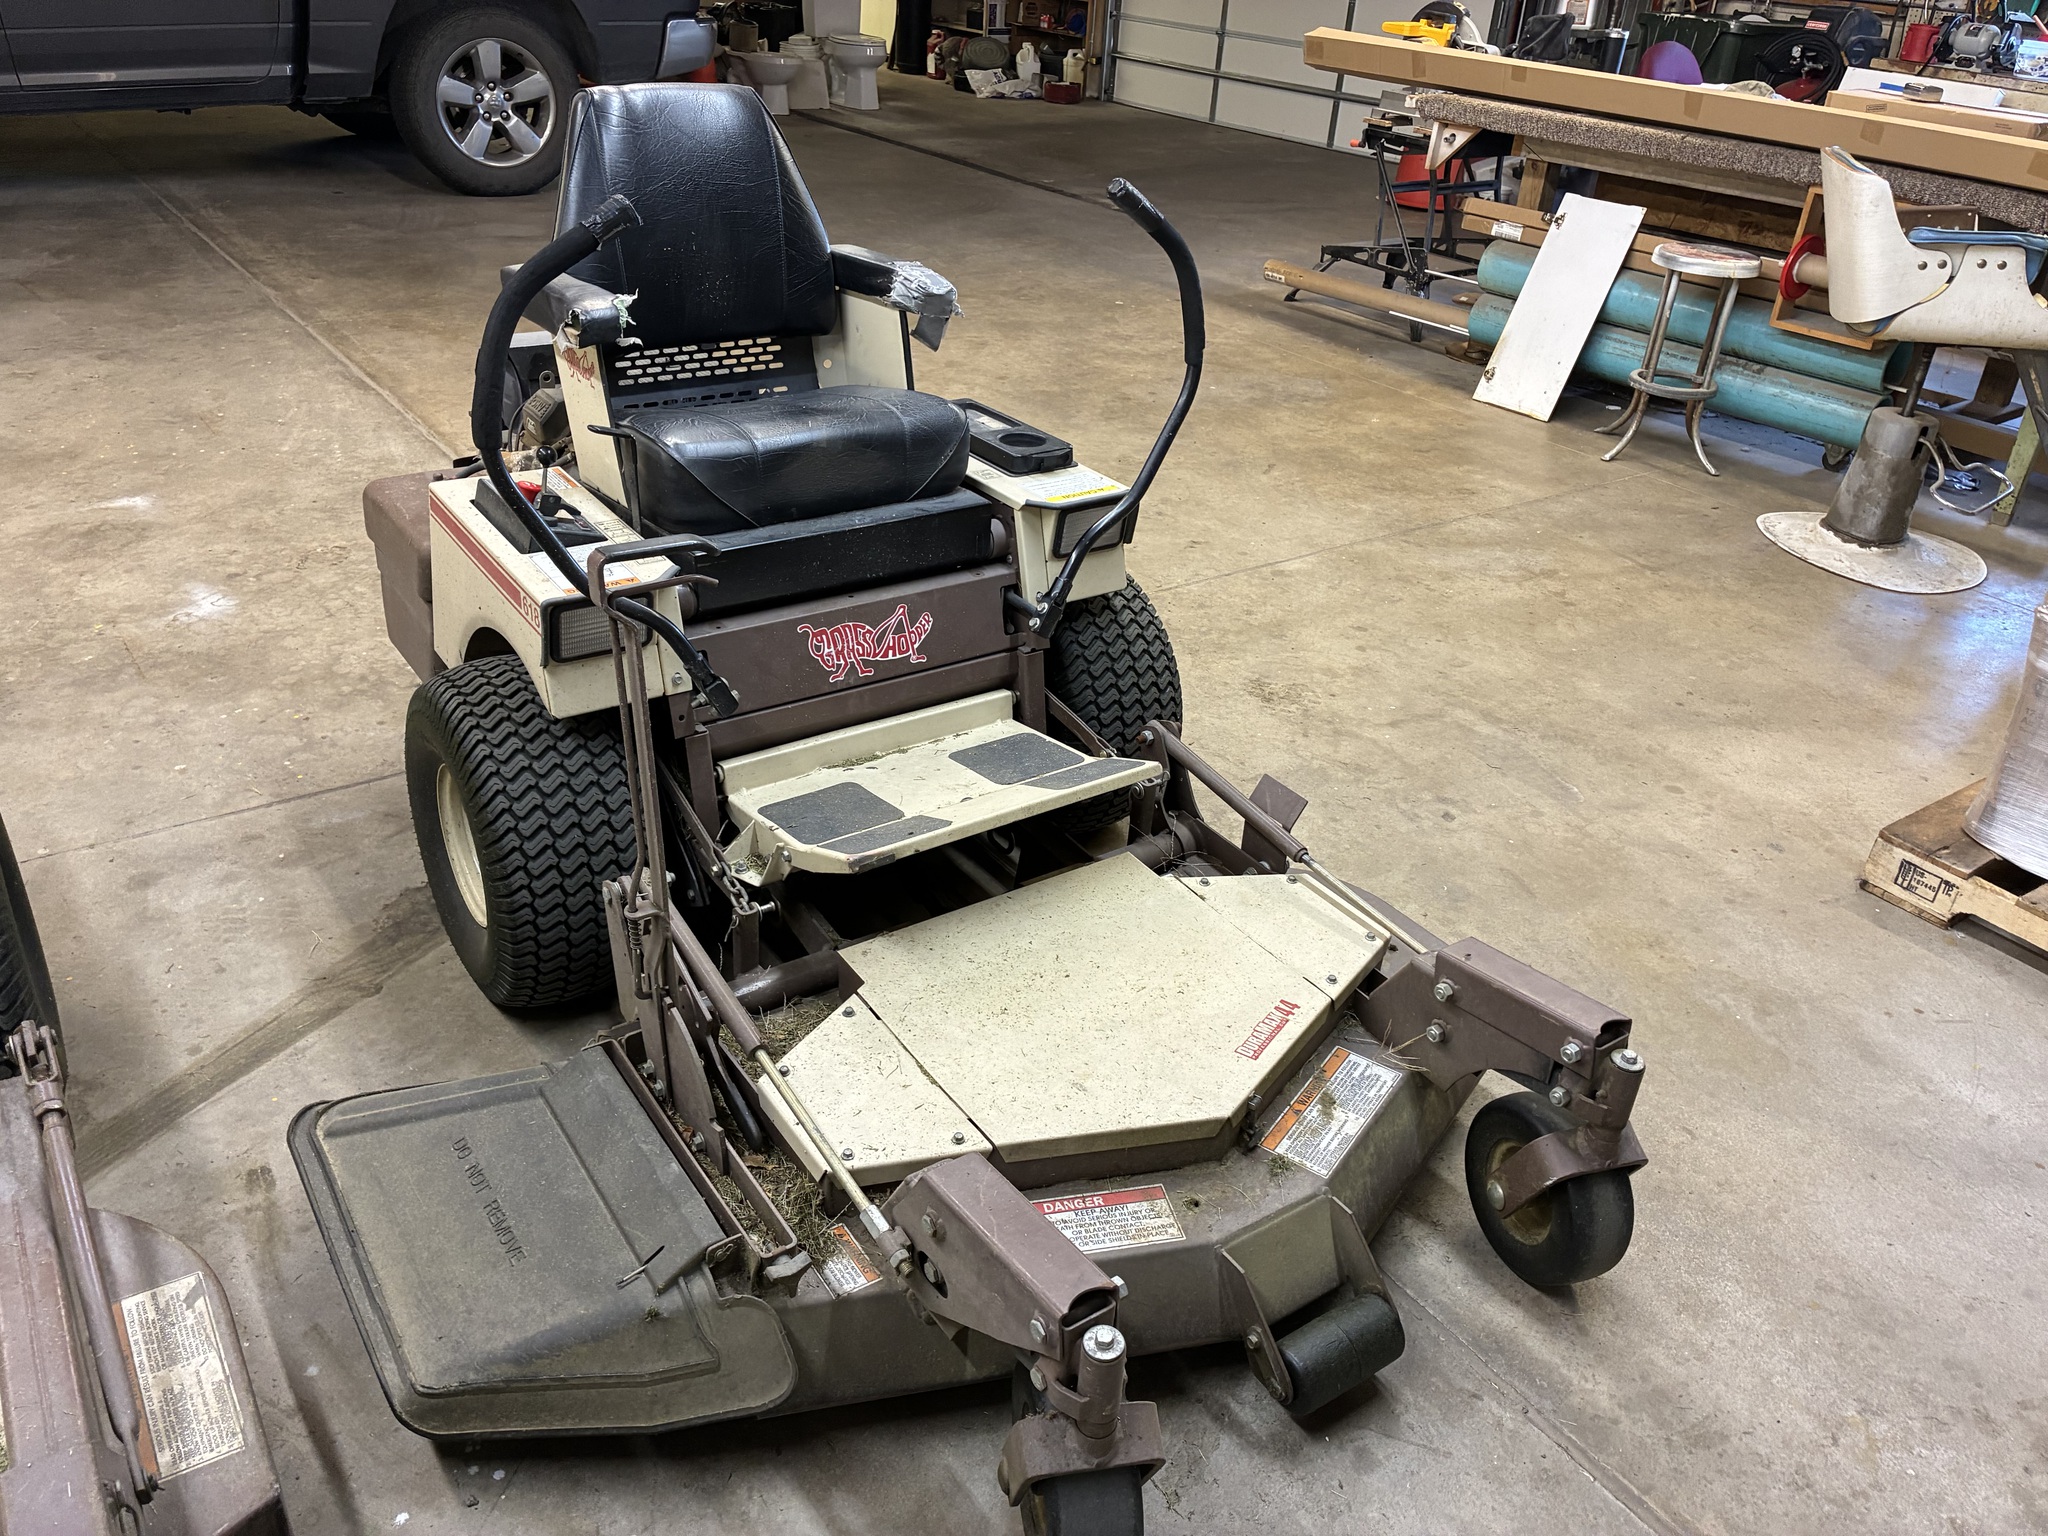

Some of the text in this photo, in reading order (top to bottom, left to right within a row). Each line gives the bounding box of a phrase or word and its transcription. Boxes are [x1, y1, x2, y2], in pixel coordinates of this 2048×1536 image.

[522, 595, 540, 628] 618
[1273, 999, 1301, 1017] 44
[452, 1135, 528, 1268] DO NOT REMOVE
[1043, 1196, 1105, 1213] DANGER
[1072, 1204, 1129, 1217] KEEP AWAY!
[1086, 1212, 1117, 1221] SERIOUS
[1117, 1209, 1143, 1217] INJURY
[1073, 1221, 1097, 1229] FROM
[1096, 1216, 1129, 1226] THROWN
[1083, 1226, 1107, 1234] BLADE
[1101, 1228, 1134, 1238] WITHOUT
[1133, 1222, 1176, 1233] DISCHARGE
